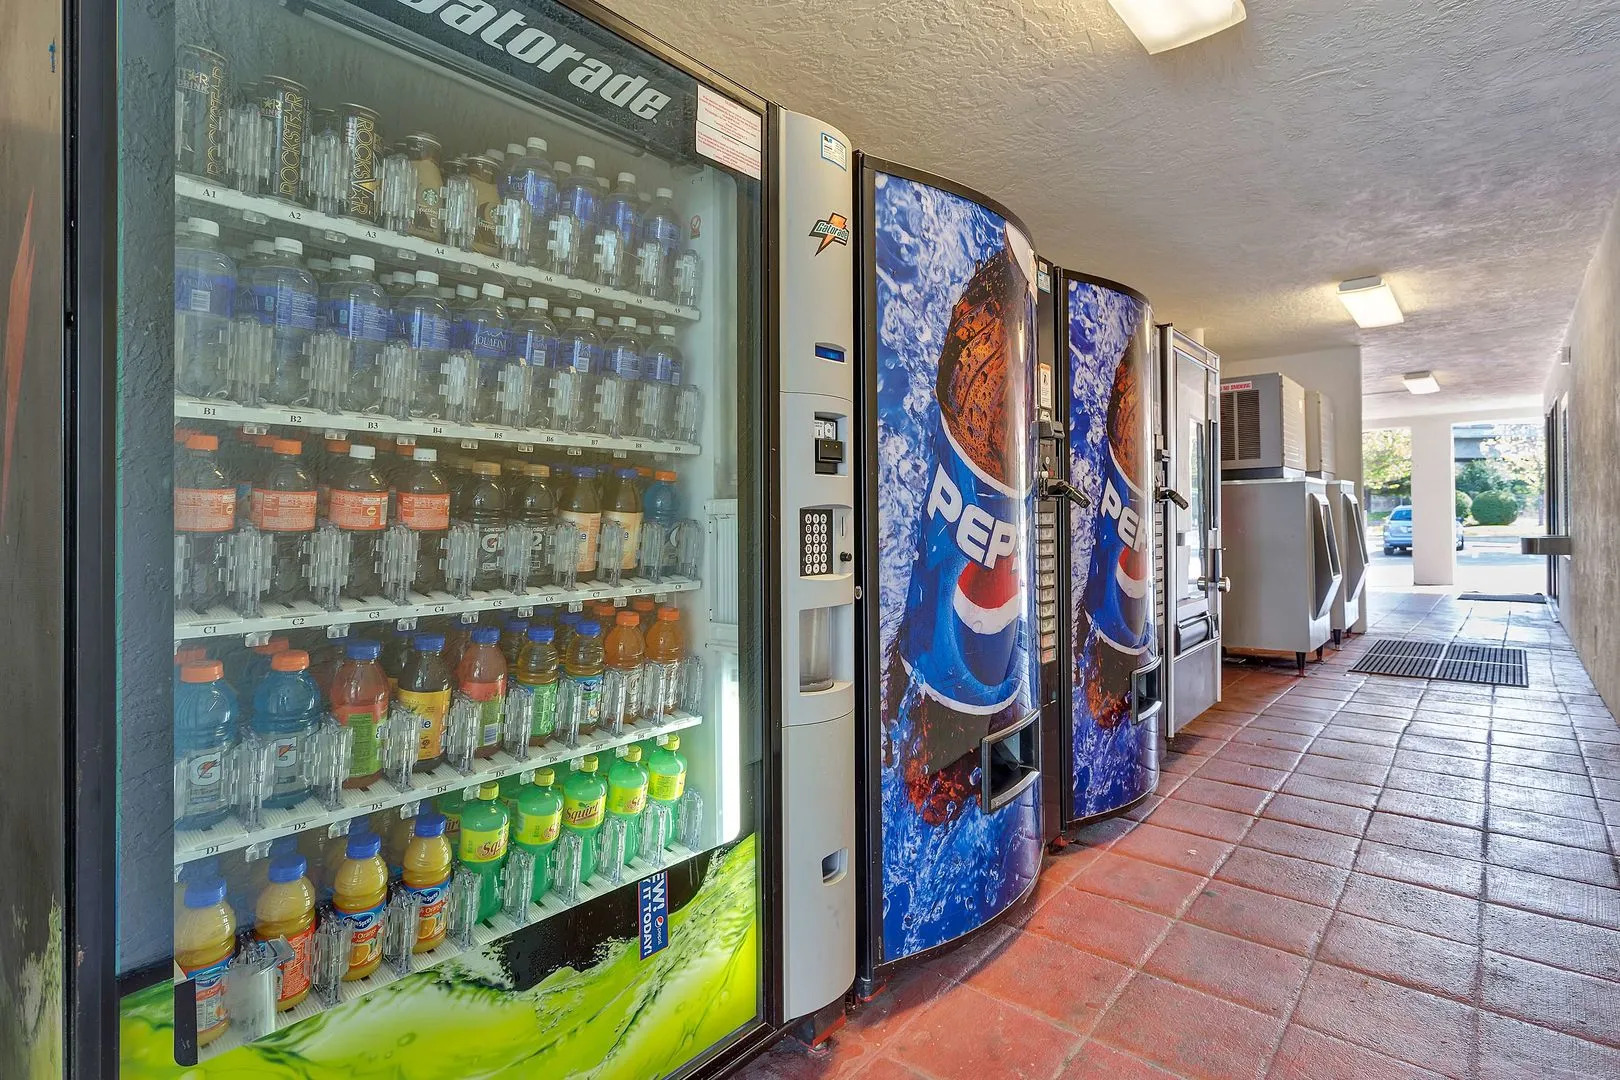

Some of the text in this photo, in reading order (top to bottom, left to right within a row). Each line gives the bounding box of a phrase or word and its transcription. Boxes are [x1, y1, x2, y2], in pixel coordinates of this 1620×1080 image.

[402, 0, 672, 121] atorade
[202, 188, 217, 199] A1
[288, 211, 302, 220] A2
[365, 230, 377, 238] A3
[815, 221, 848, 241] Gatorade
[203, 407, 216, 416] B1
[290, 415, 302, 423] B2
[367, 422, 379, 430] B3
[927, 463, 1018, 570] PEP
[434, 606, 445, 614] C4
[368, 611, 380, 619] C3
[292, 617, 304, 626] C2
[203, 626, 217, 634] C1
[437, 786, 447, 794] D4
[371, 802, 383, 810] D3
[564, 802, 600, 823] Squirt
[294, 822, 306, 831] D2
[206, 846, 220, 854] D1
[643, 886, 651, 900] IT
[644, 902, 652, 956] TODAY!
